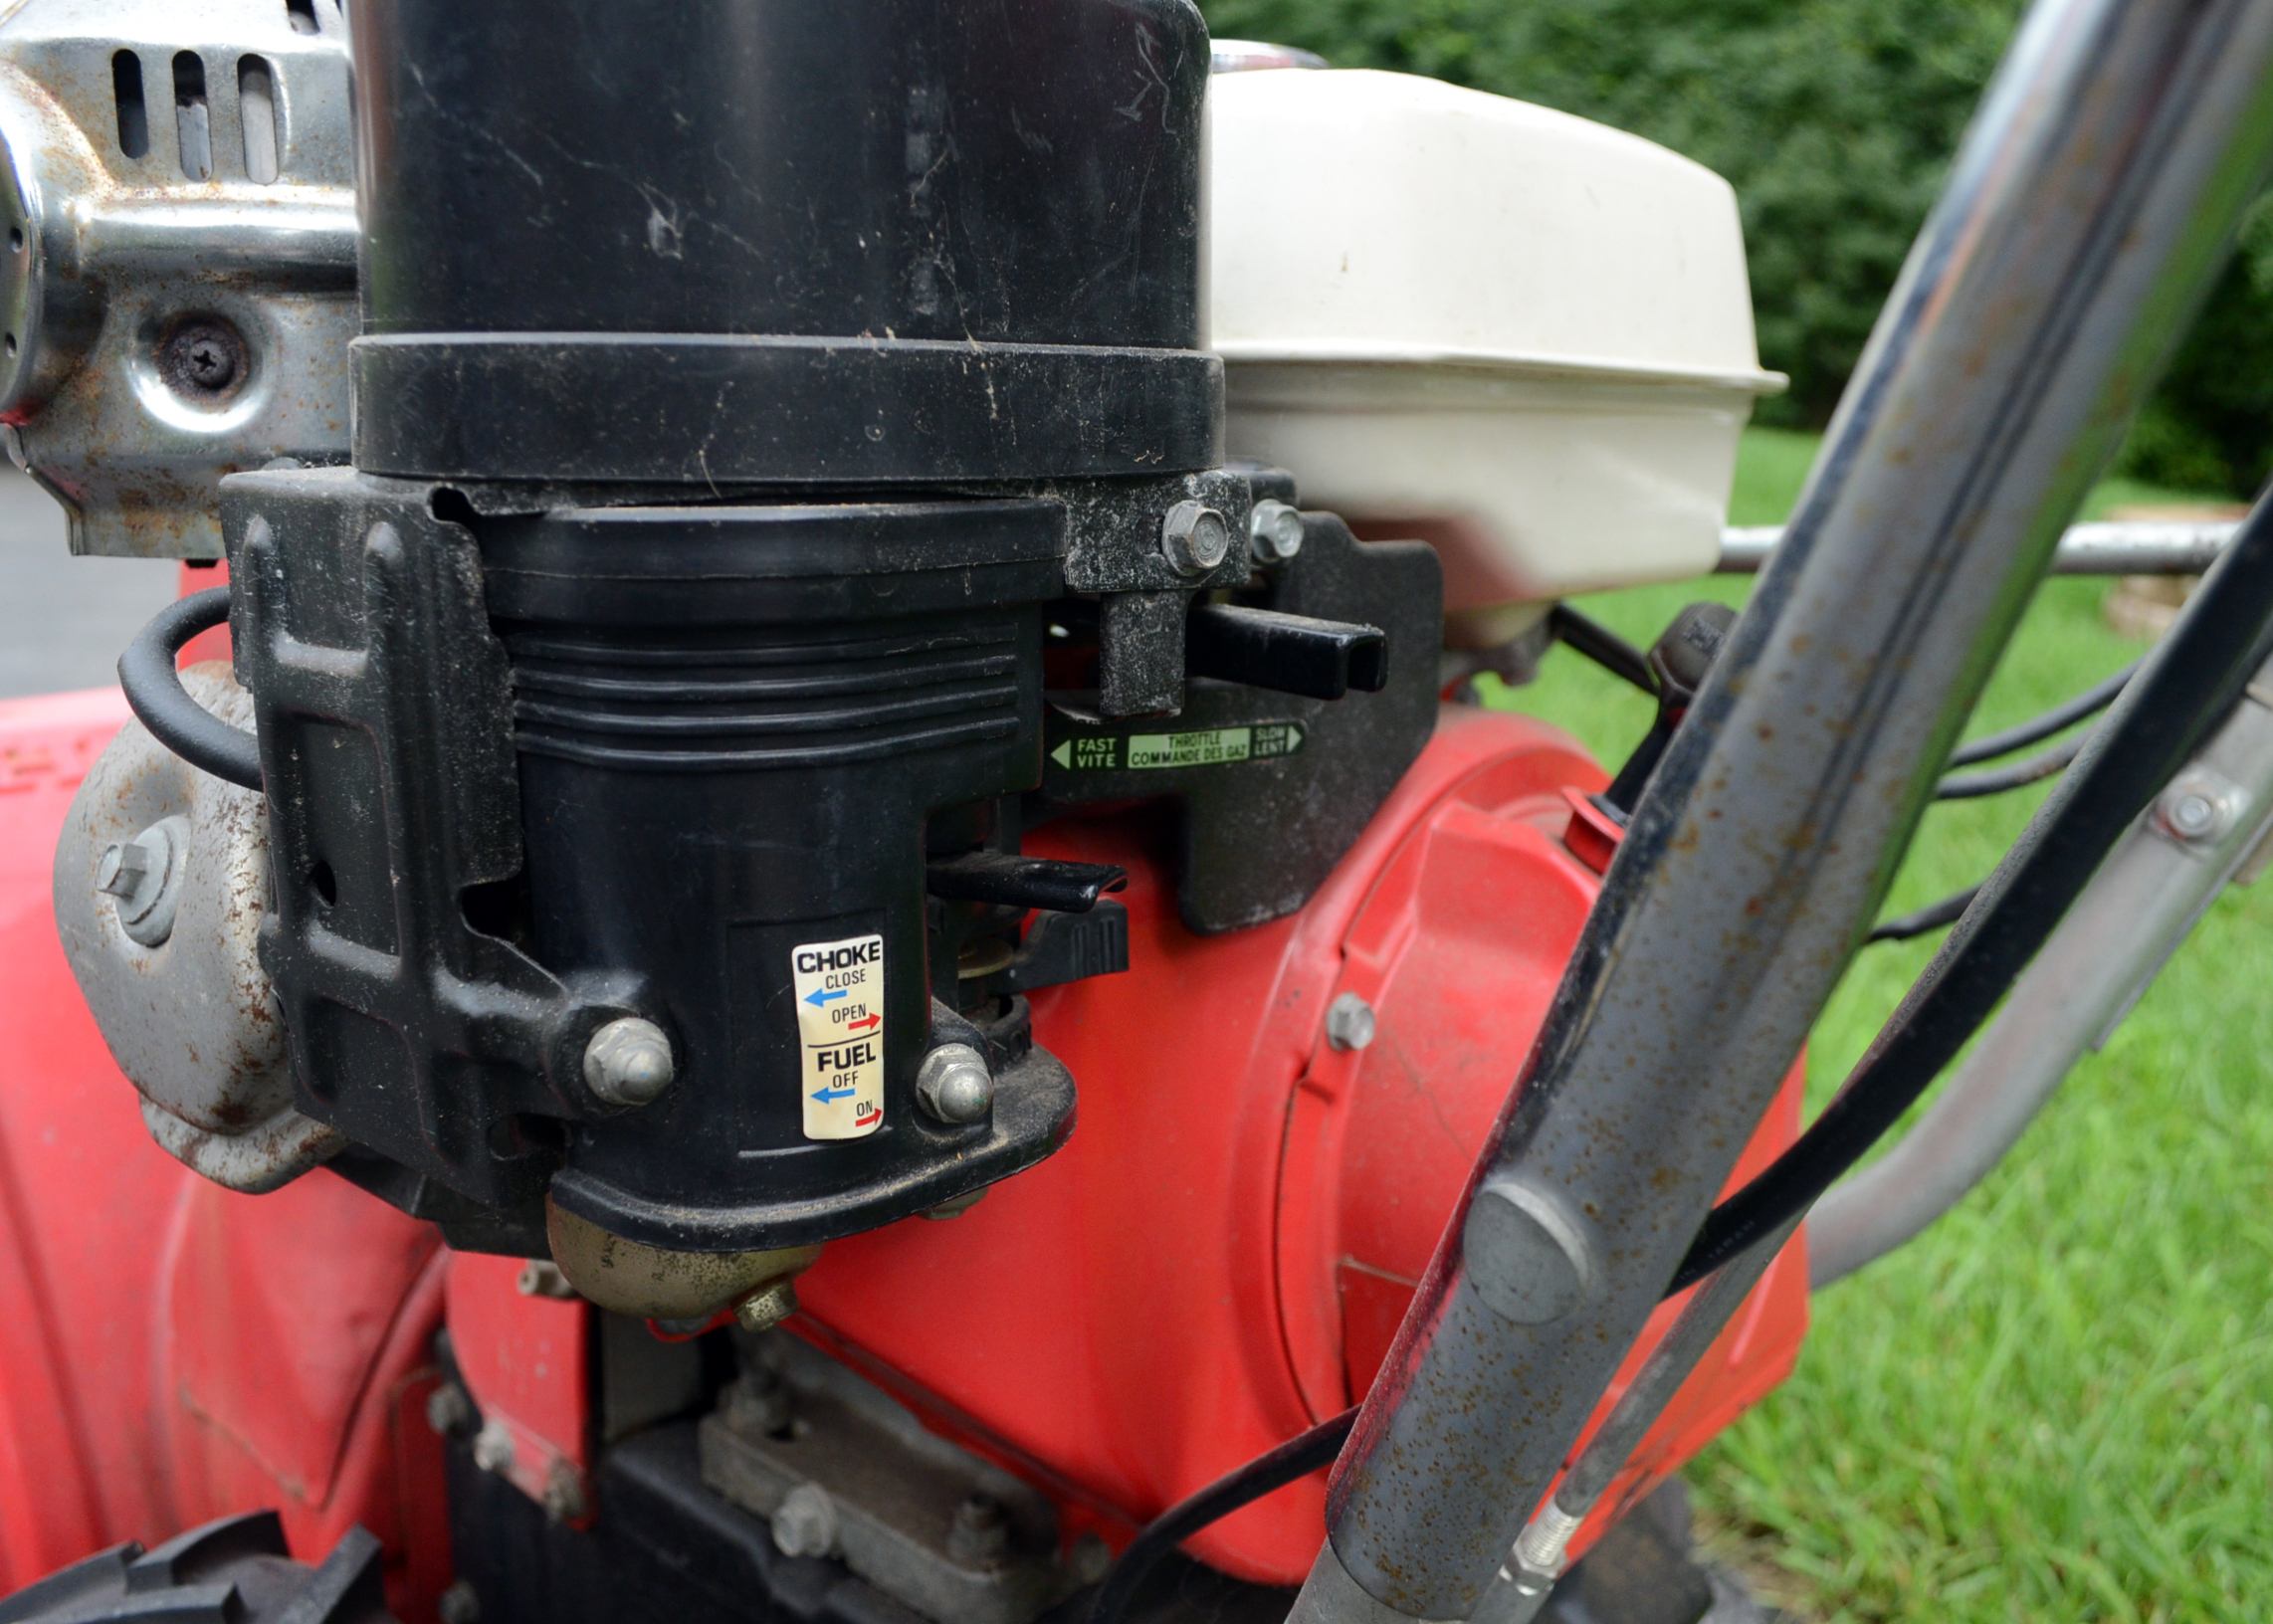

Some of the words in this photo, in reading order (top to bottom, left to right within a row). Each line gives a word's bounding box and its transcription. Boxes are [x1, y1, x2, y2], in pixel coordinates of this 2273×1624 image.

[1077, 737, 1117, 752] FAST
[1167, 731, 1222, 747] THROTTLE
[1077, 753, 1117, 768] VITE
[1131, 747, 1200, 766] COMMANDE
[1204, 744, 1223, 760] DES
[797, 940, 881, 973] CHOKE
[825, 968, 867, 989] CLOSE
[832, 1003, 867, 1024] OPEN
[817, 1042, 877, 1072] FUEL
[832, 1071, 859, 1089] OFF
[856, 1099, 873, 1117] ON
